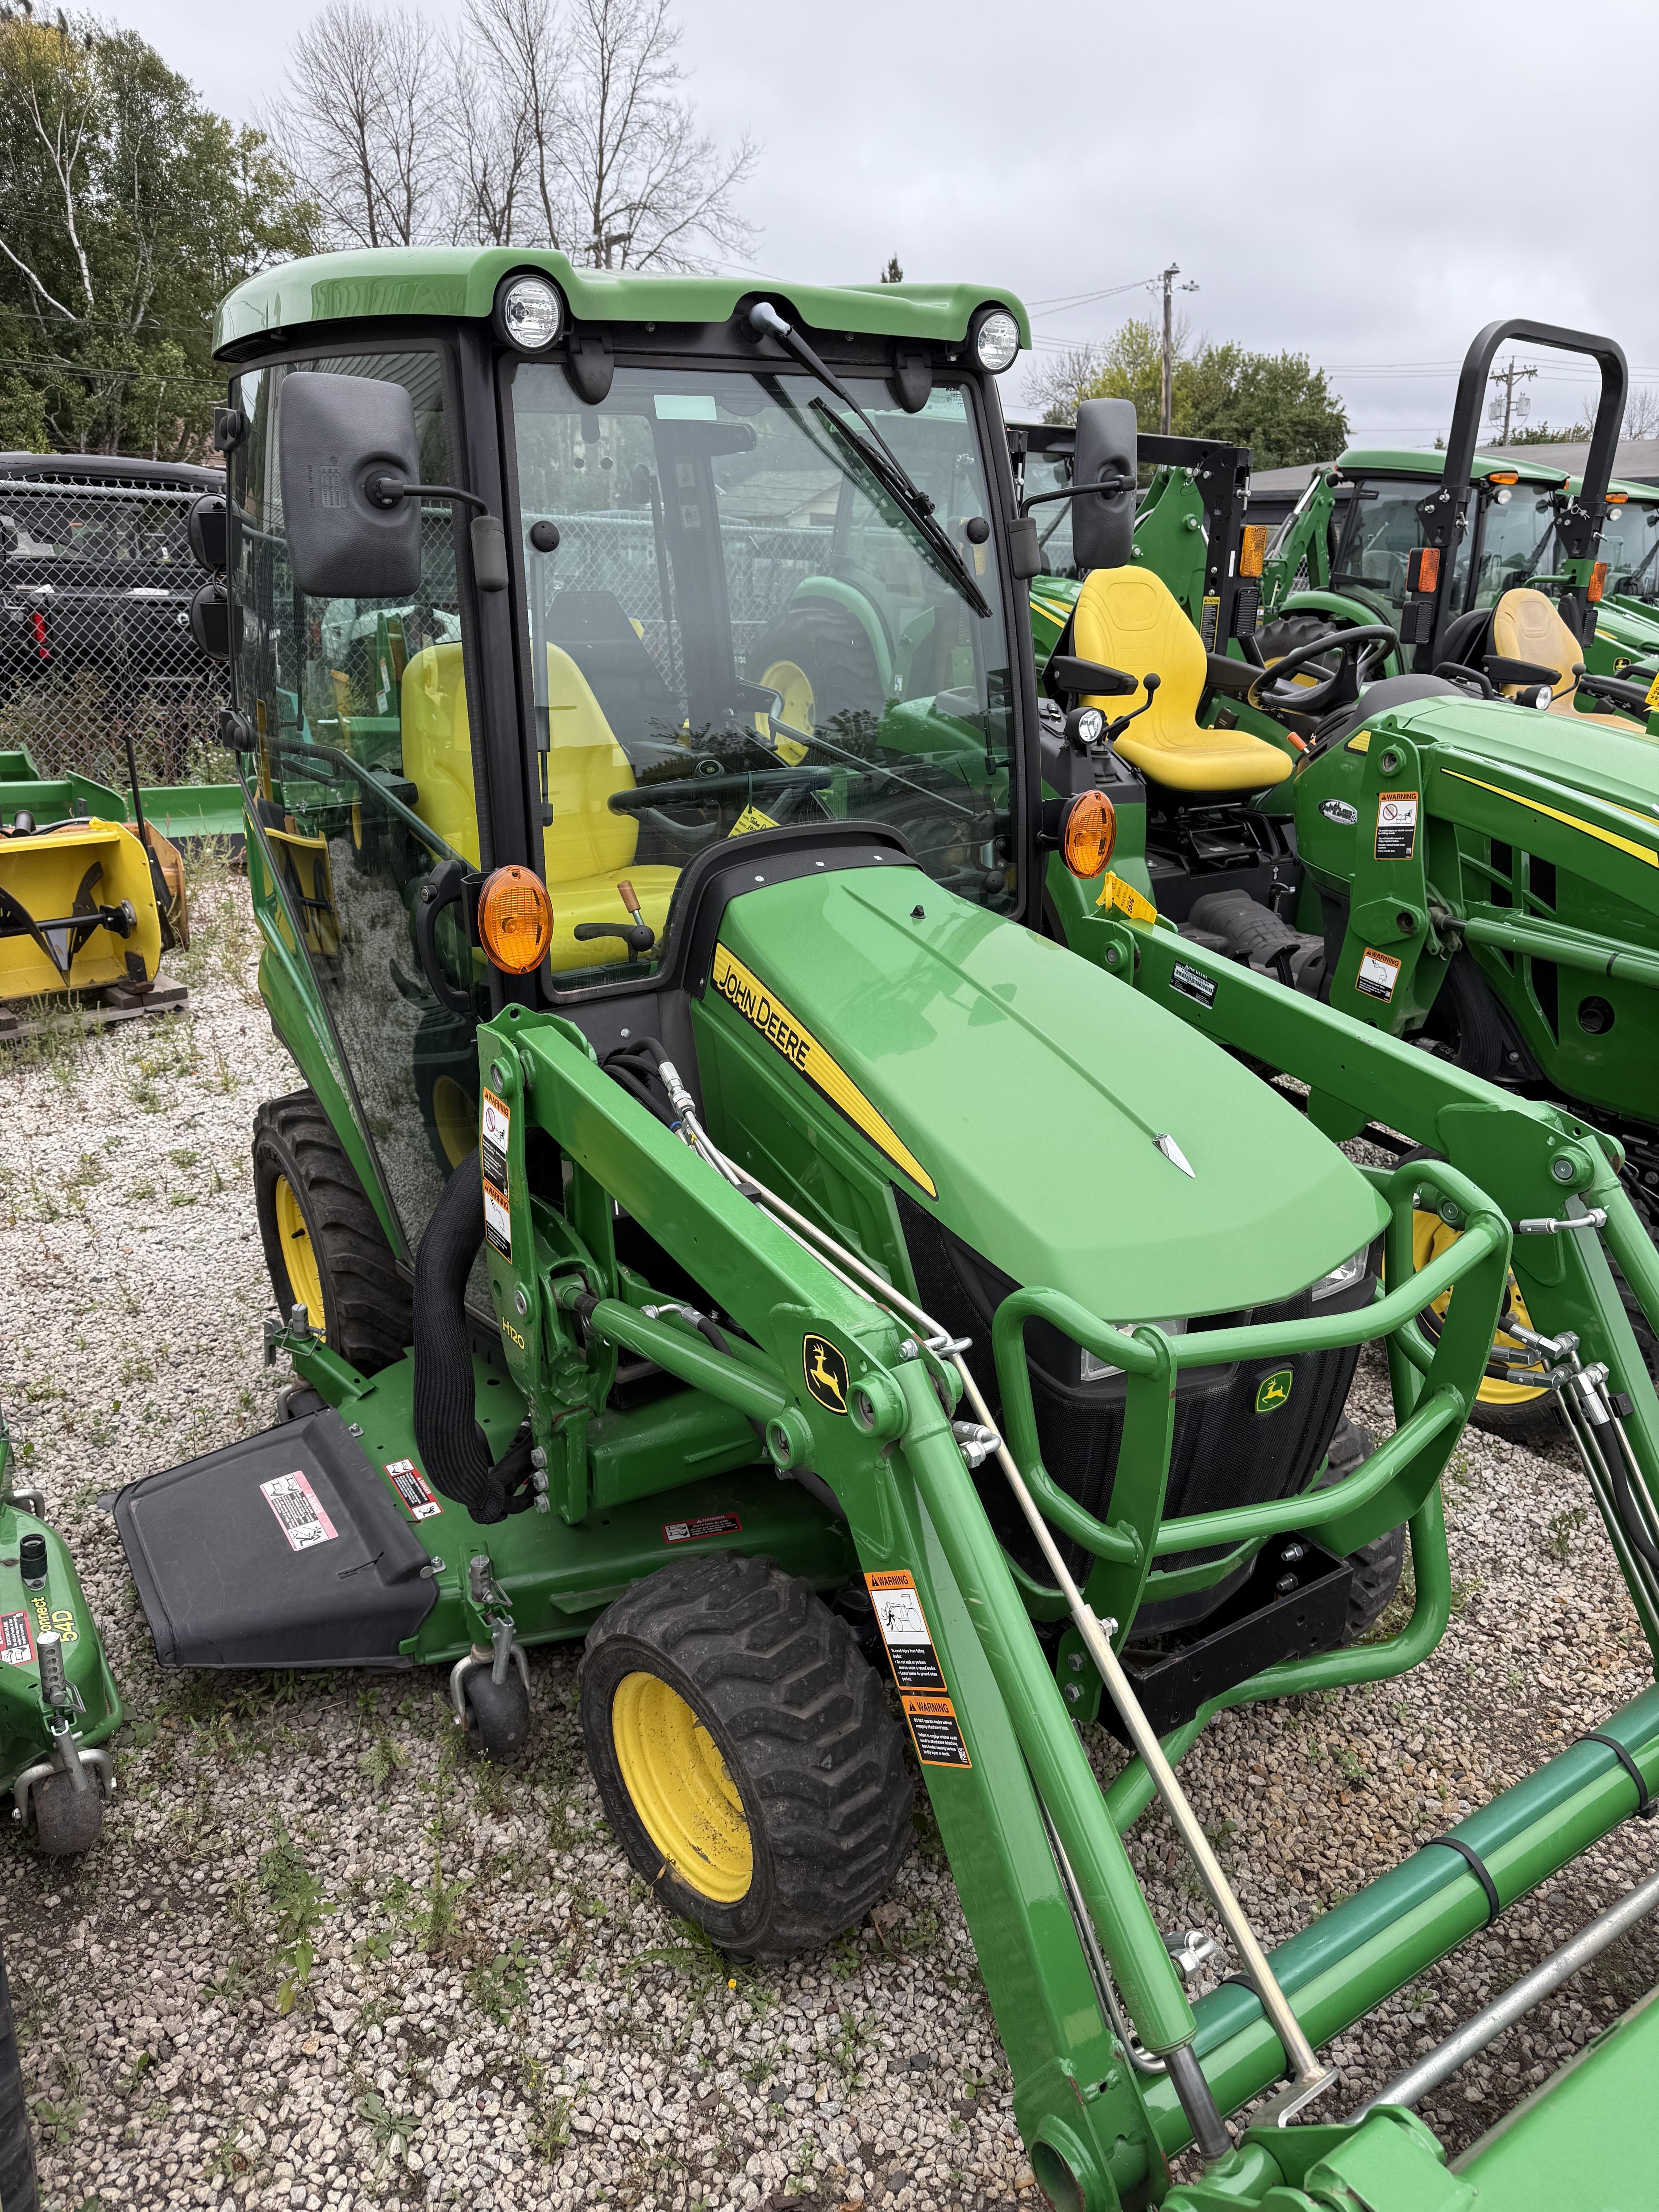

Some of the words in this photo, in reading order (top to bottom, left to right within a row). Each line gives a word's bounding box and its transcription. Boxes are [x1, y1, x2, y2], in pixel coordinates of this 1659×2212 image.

[1372, 951, 1399, 966] WARNING
[719, 965, 756, 1015] JOHN
[756, 996, 811, 1068] DEERE
[488, 1093, 508, 1116] WARNING
[488, 1185, 508, 1211] WARNING
[419, 1479, 431, 1495] DANGER
[878, 1575, 908, 1586] WARNING
[52, 1610, 78, 1642] 54D
[916, 1702, 949, 1713] WARNING
